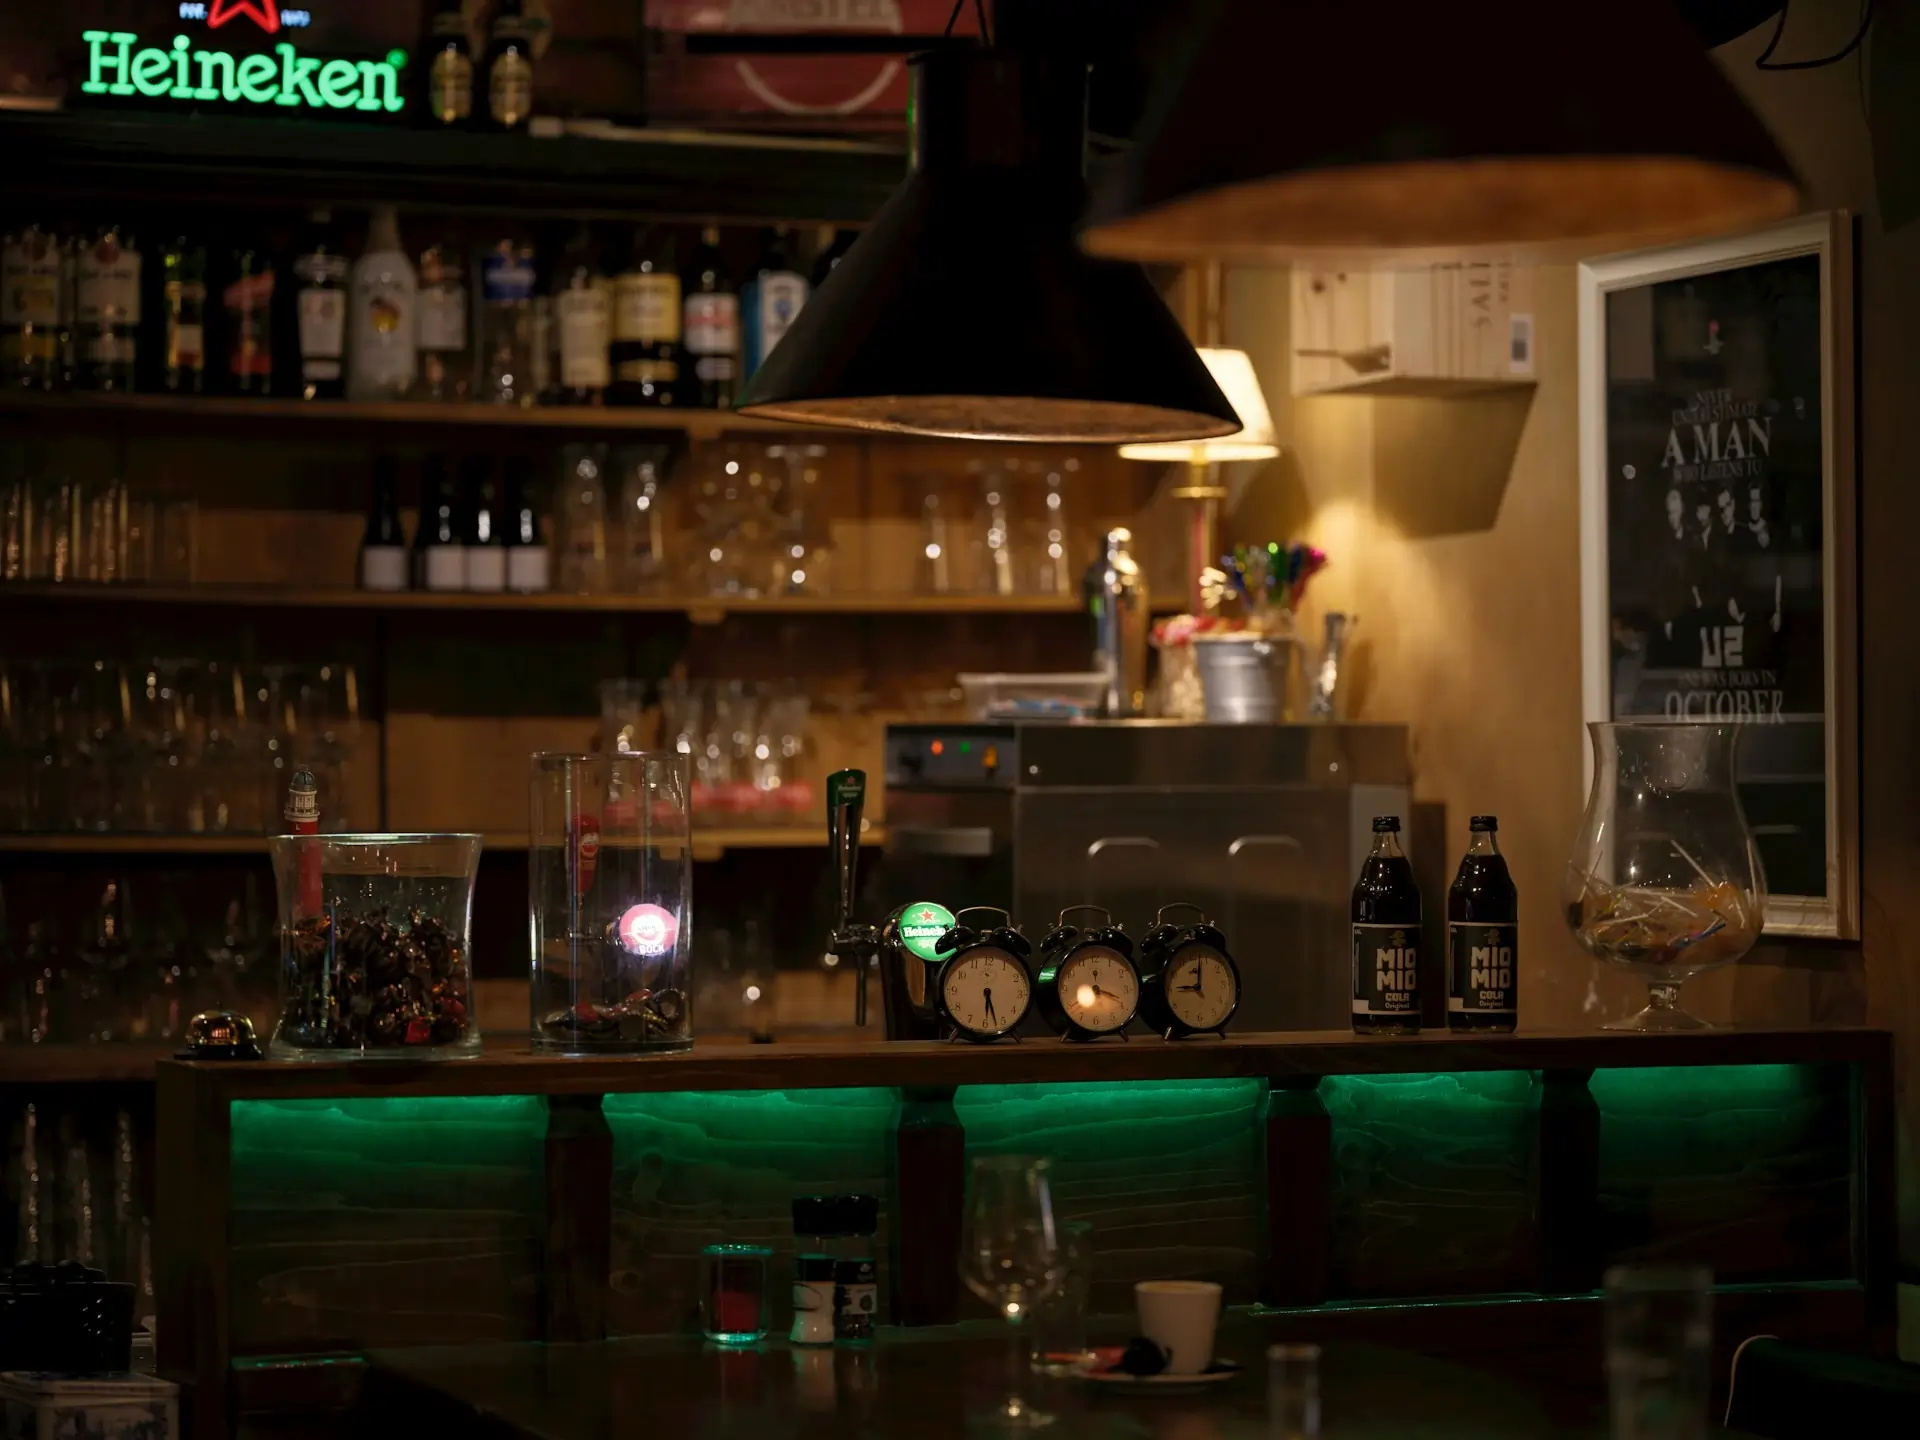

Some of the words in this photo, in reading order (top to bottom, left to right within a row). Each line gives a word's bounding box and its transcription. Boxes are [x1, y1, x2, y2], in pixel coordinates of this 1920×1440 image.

[82, 31, 405, 112] Heineken
[1660, 426, 1685, 469] A
[1692, 416, 1773, 465] MAN
[1664, 689, 1785, 724] OCTOBER
[1376, 947, 1417, 970] MIO
[1471, 946, 1512, 968] MIO
[1376, 969, 1416, 992] MIO
[1470, 968, 1511, 990] MIO
[1385, 992, 1410, 1002] COLA
[1479, 990, 1504, 1000] COLA
